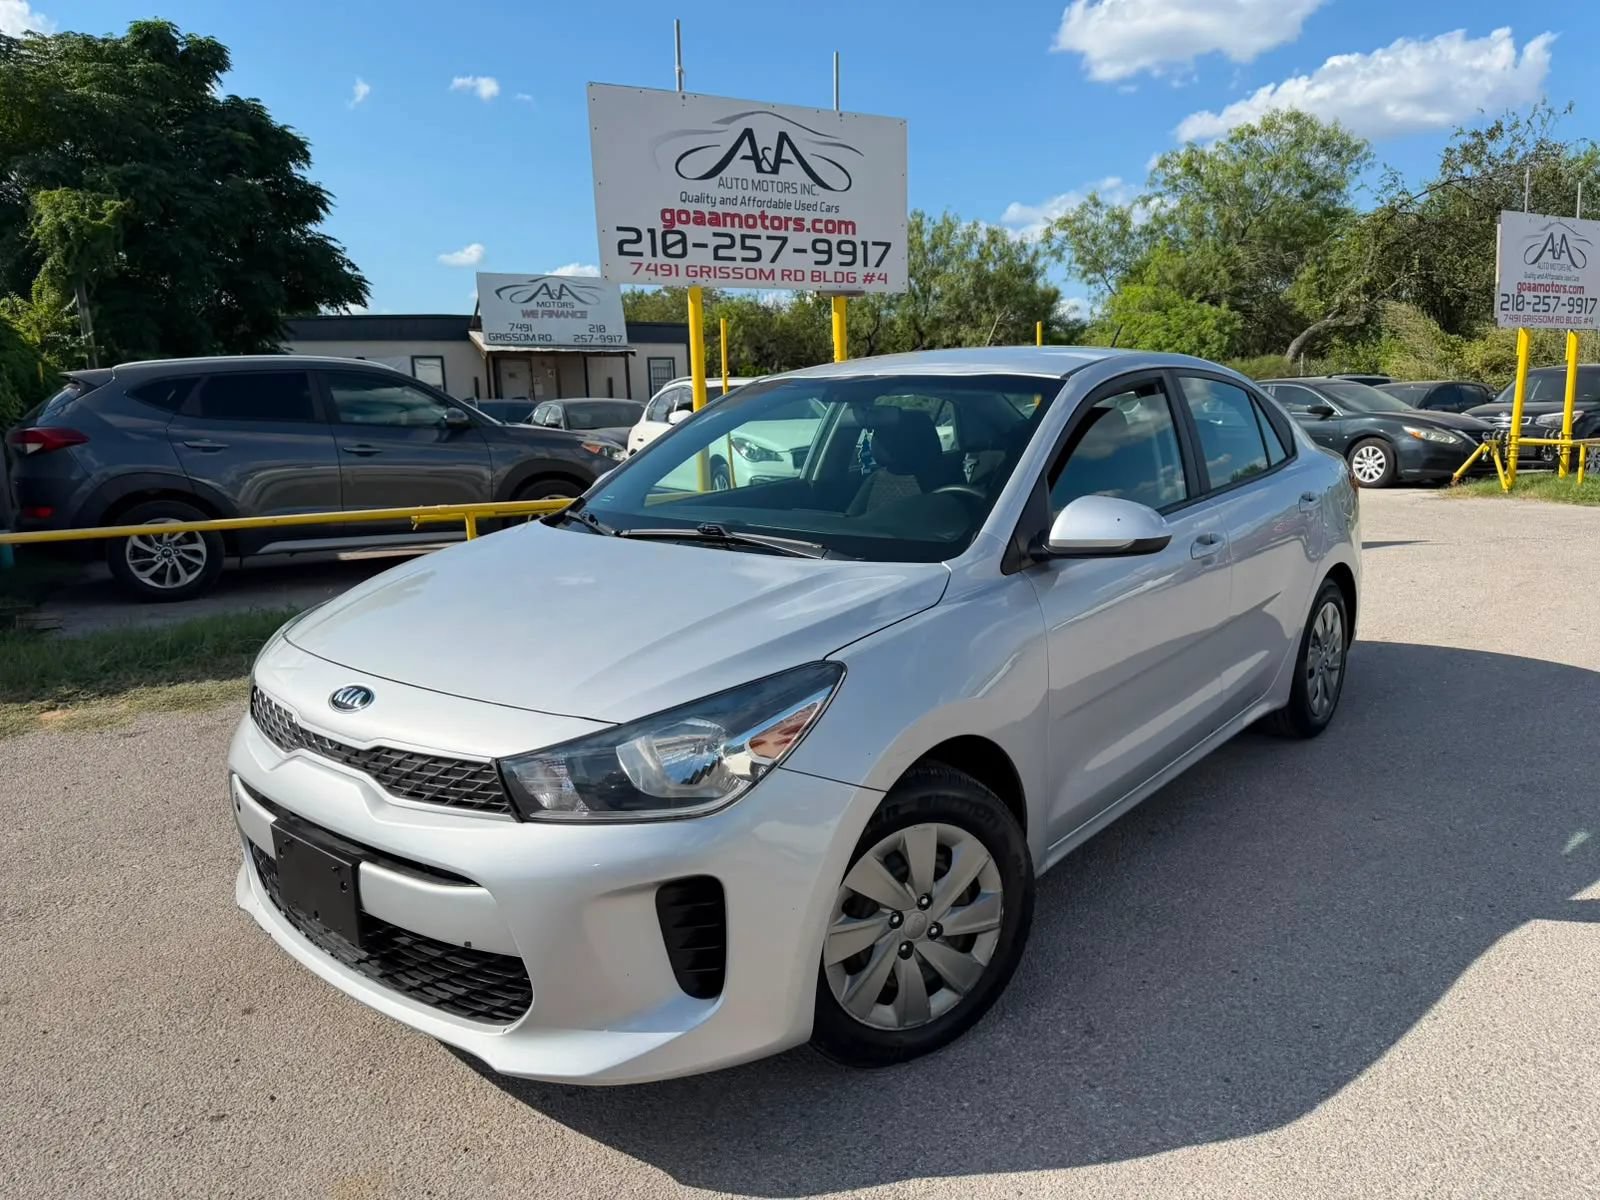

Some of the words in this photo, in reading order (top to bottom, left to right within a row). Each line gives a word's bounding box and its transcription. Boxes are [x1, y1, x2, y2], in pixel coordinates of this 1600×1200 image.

[717, 176, 749, 191] AUTO
[751, 178, 798, 195] MOTORS
[800, 183, 820, 197] INC.
[680, 191, 717, 208] Quality
[719, 194, 738, 206] and
[739, 195, 792, 210] Affordable
[794, 199, 818, 212] Used
[819, 201, 840, 214] Cars
[660, 208, 856, 235] goaamotors.com
[615, 226, 892, 269] 210-257-9917
[629, 262, 680, 277] 7491
[686, 265, 775, 282] GRISSOM
[781, 269, 805, 283] RD
[811, 270, 857, 284] BLDG
[862, 272, 888, 285] #4
[1517, 281, 1585, 295] goaamotors.com
[536, 301, 575, 309] MOTORS
[1500, 293, 1598, 315] 210-257-9917
[521, 309, 539, 319] WE
[540, 310, 588, 319] FINANCE
[1503, 314, 1521, 323] 7491
[1522, 314, 1555, 323] GRISSOM
[1555, 315, 1565, 324] RD
[1565, 316, 1583, 324] BLDG
[508, 322, 533, 332] 7491
[488, 332, 536, 341] GRISSOM
[573, 334, 623, 344] 257-9917
